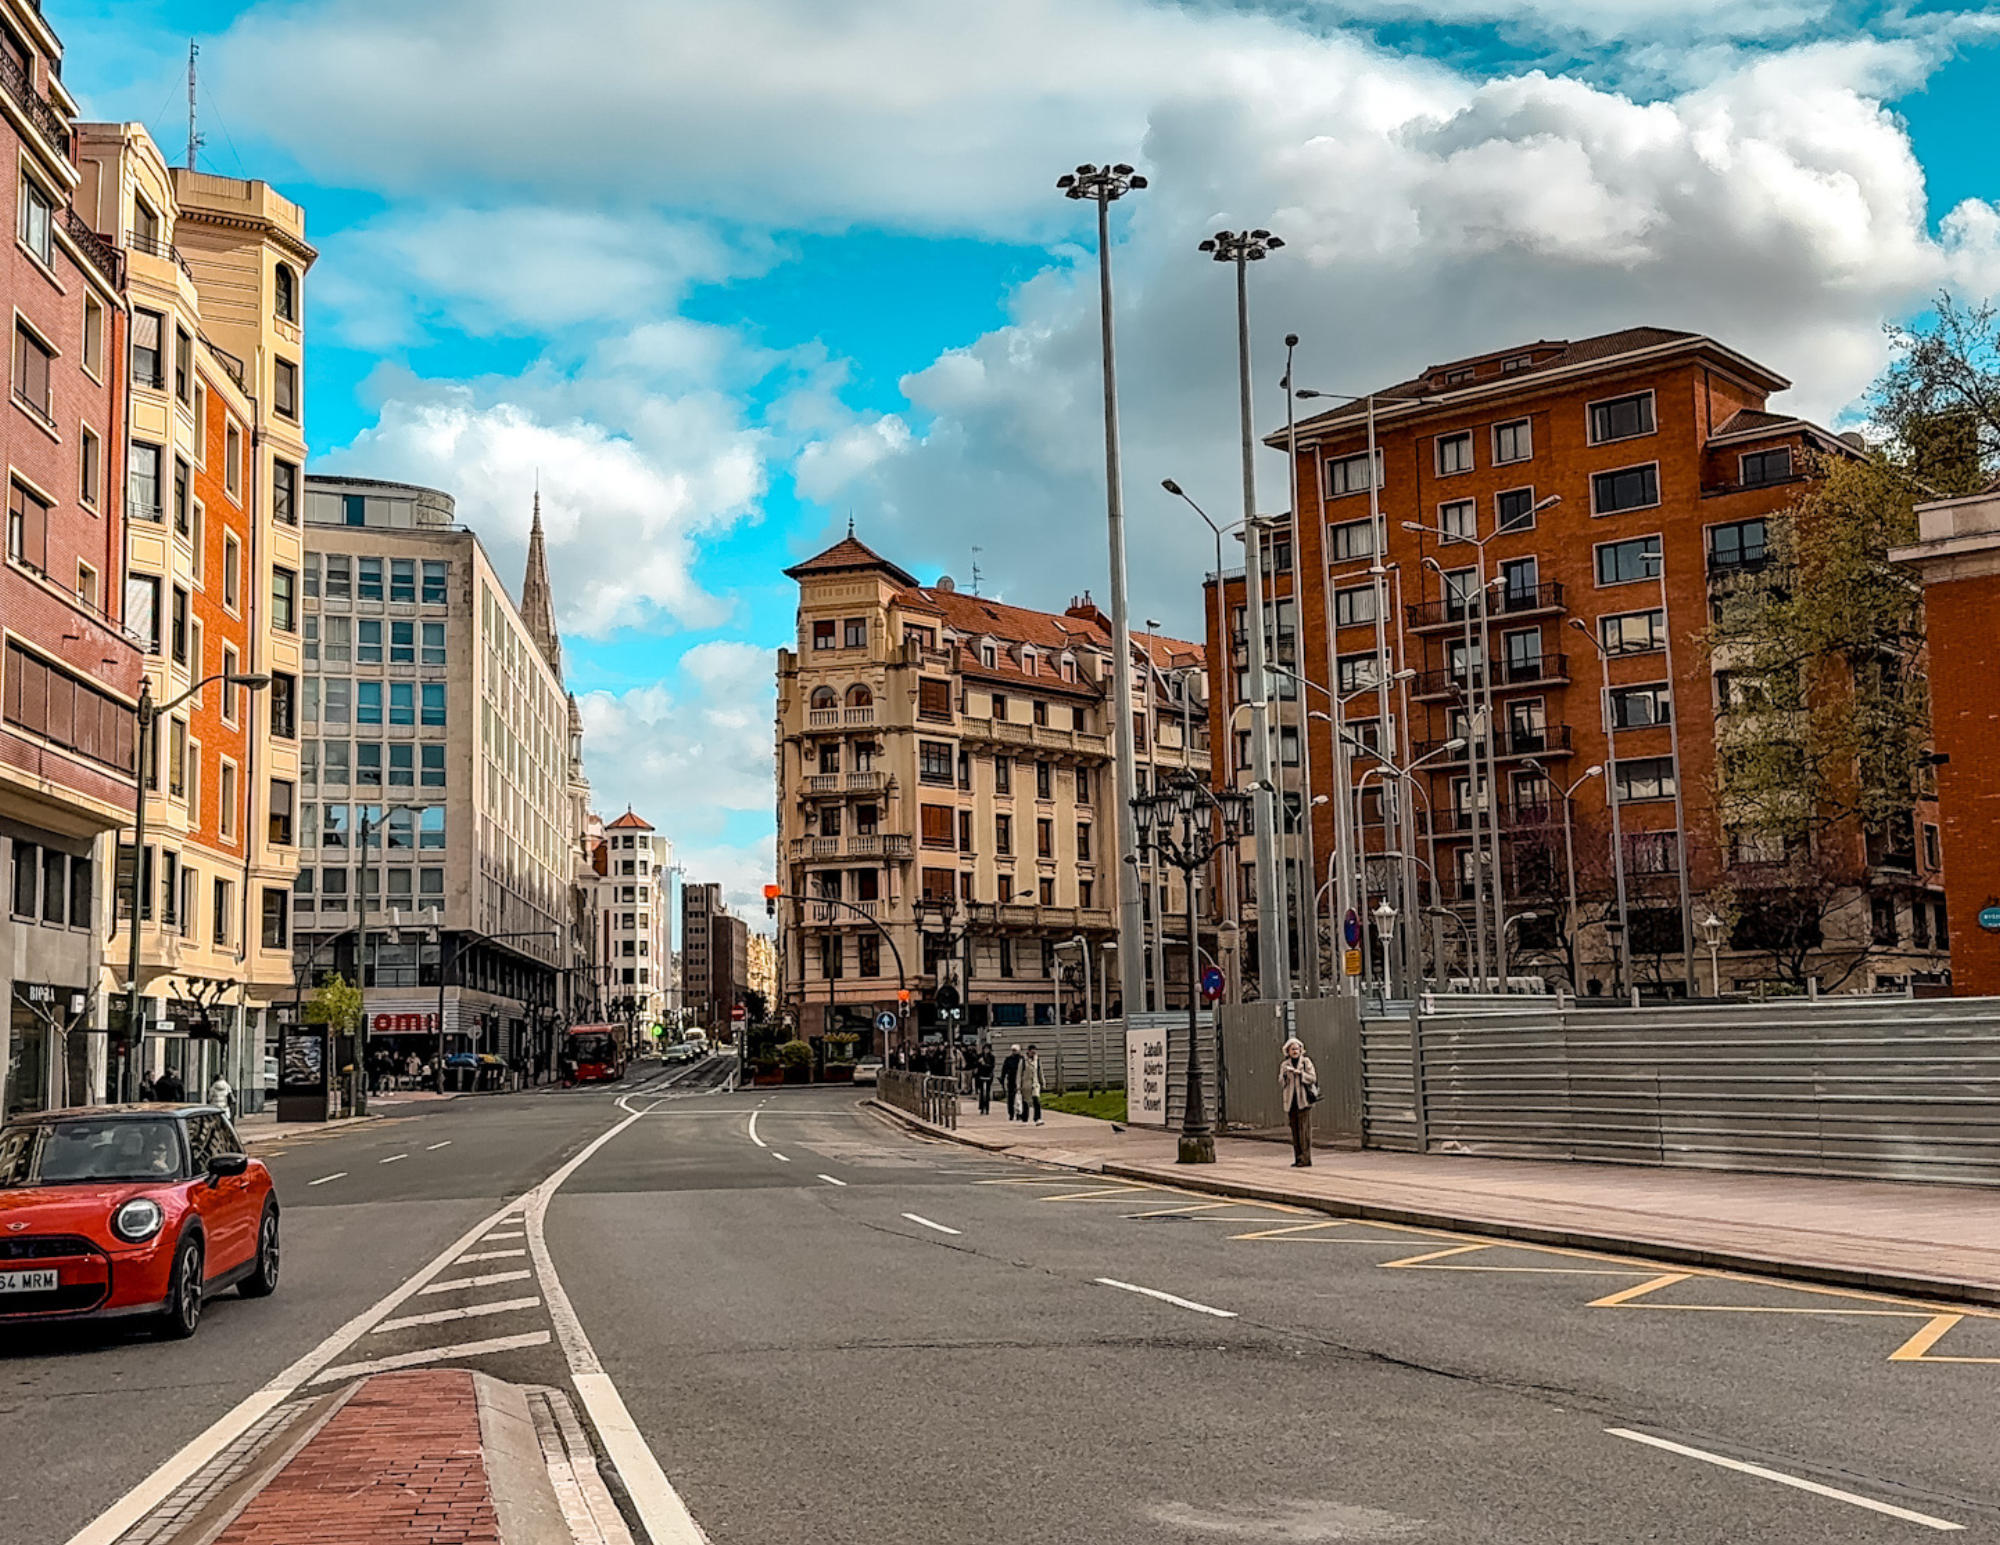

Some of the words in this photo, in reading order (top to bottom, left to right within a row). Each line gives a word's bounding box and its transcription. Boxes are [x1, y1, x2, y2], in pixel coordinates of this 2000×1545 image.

[1143, 1060, 1163, 1075] Abierto
[1143, 1078, 1158, 1096] Open
[1143, 1096, 1161, 1112] Ouvert
[22, 1273, 54, 1289] MRM
